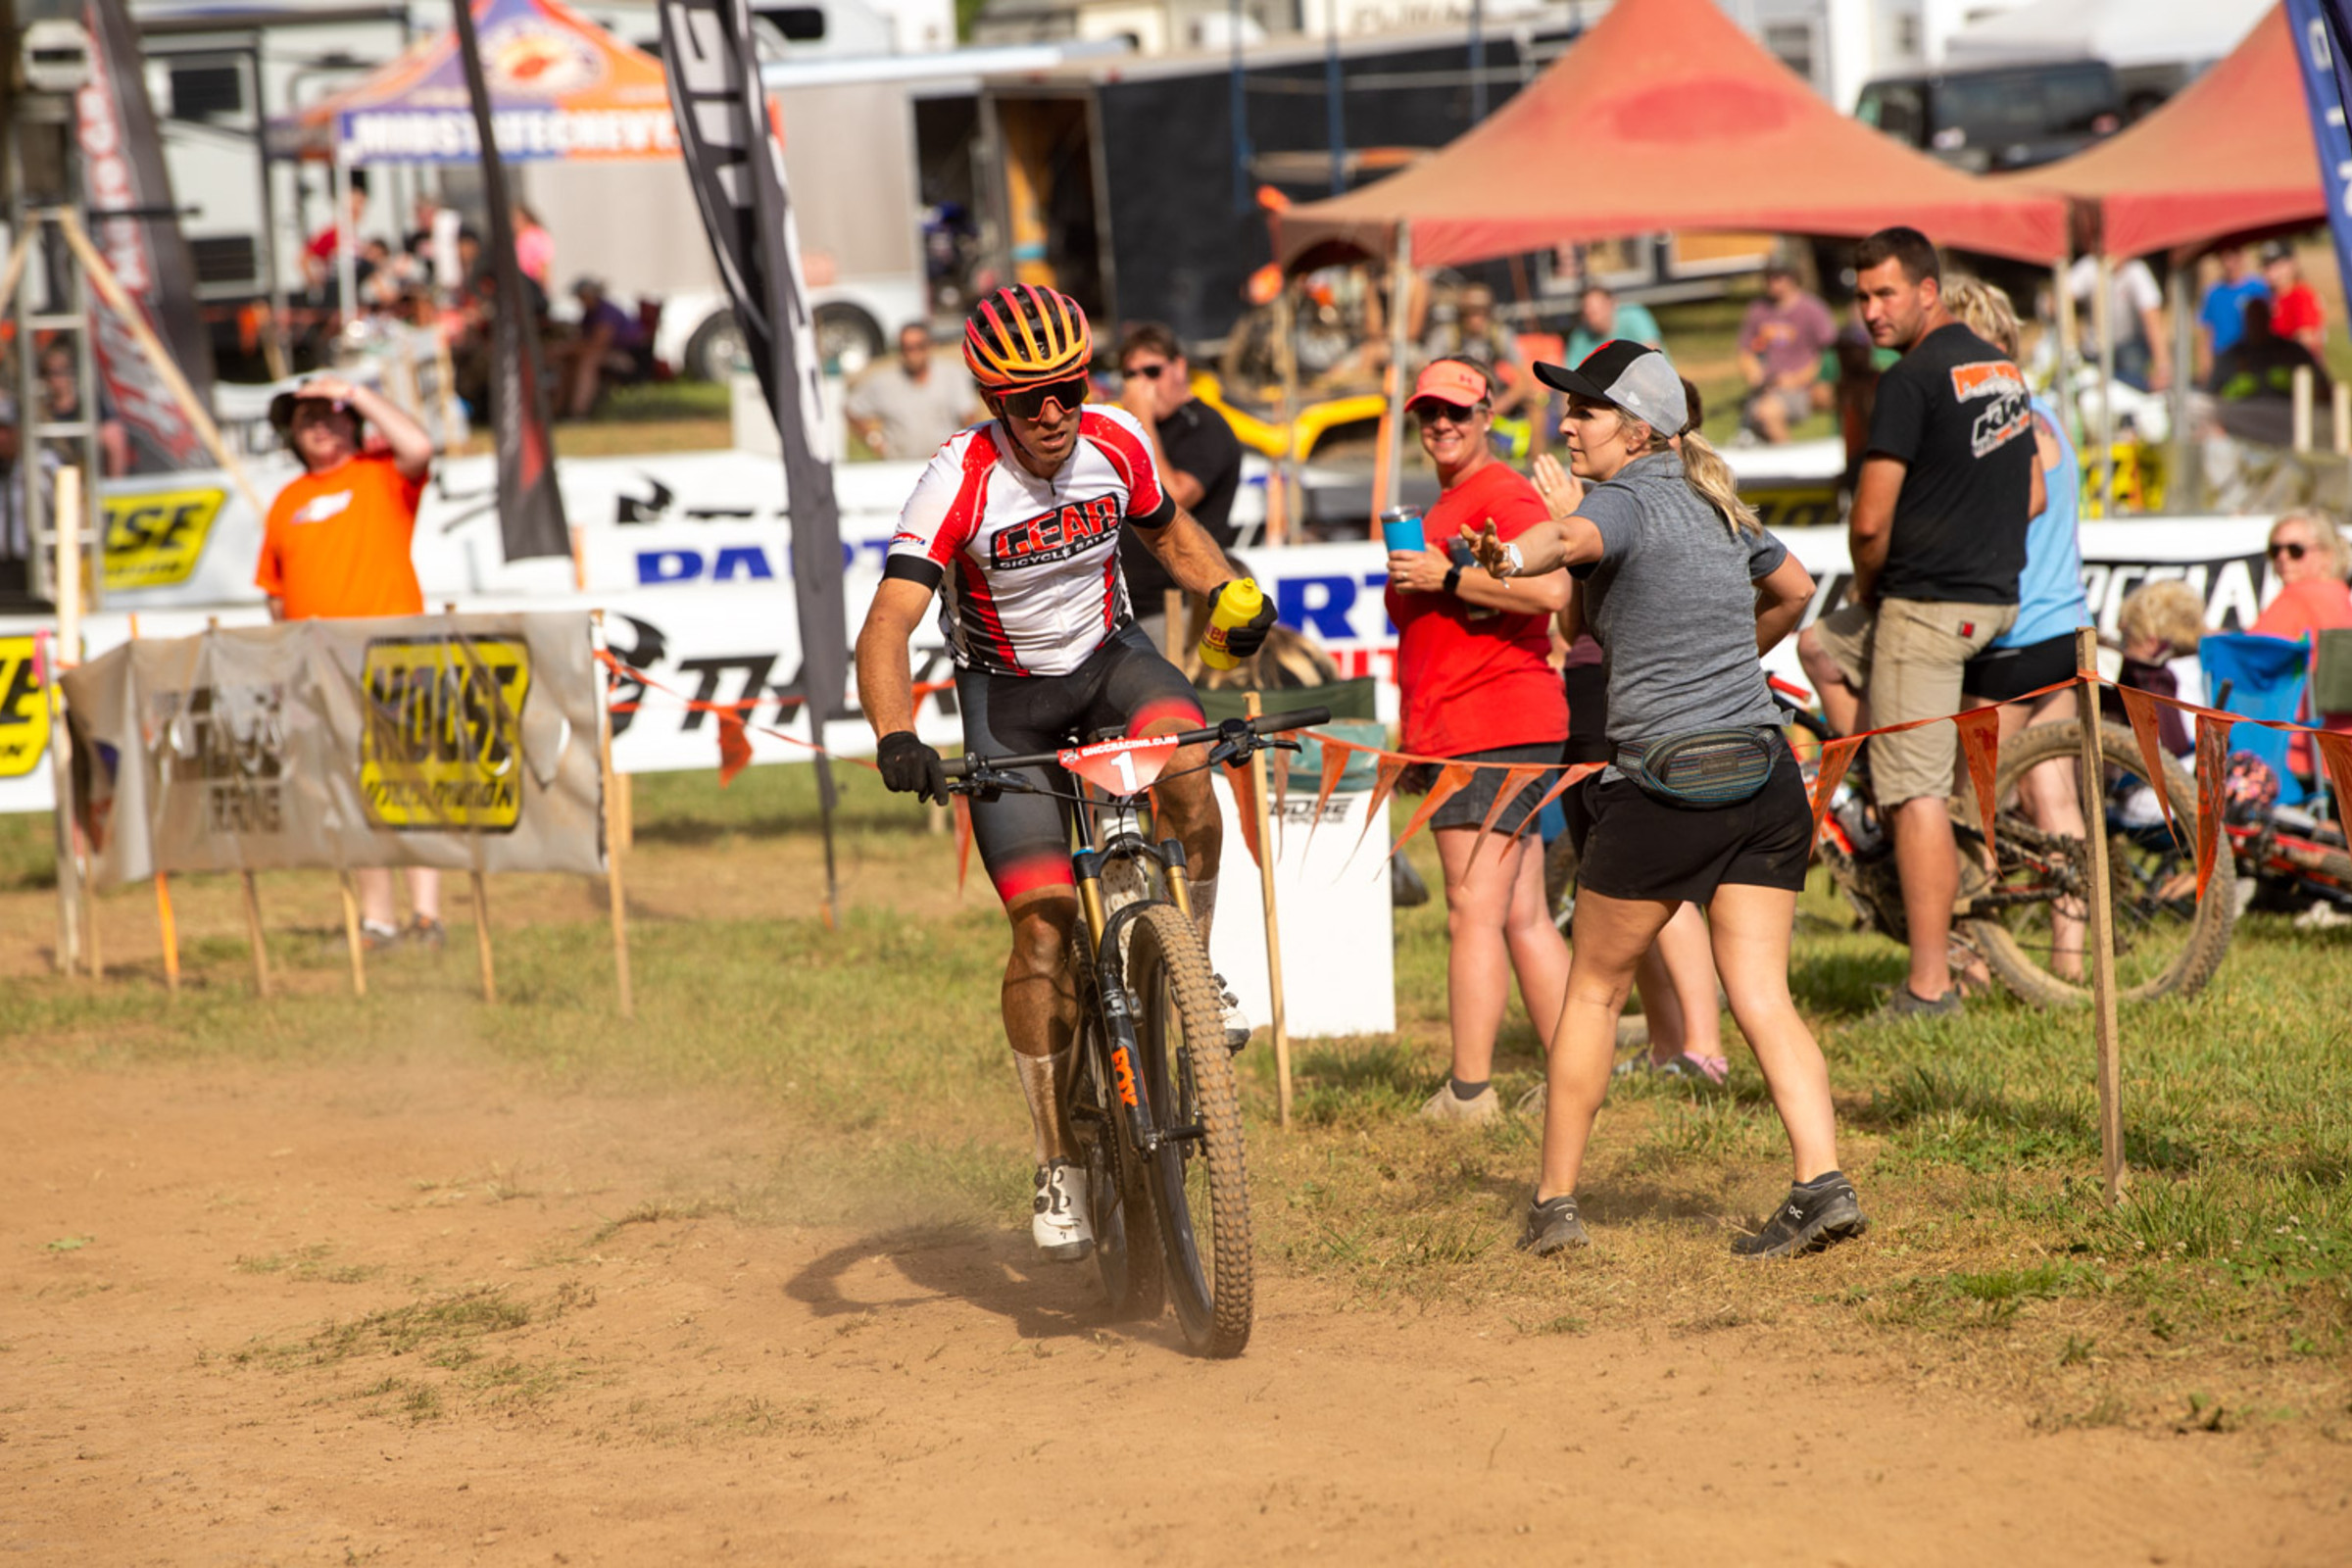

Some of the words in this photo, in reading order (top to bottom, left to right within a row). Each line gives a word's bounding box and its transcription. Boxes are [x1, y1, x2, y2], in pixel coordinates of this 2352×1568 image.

[996, 496, 1118, 561] GEAR
[999, 548, 1071, 569] BICYCLE
[1081, 735, 1178, 758] GNCCRACING.COM
[1110, 750, 1138, 792] 1
[1111, 1046, 1138, 1105] FOX
